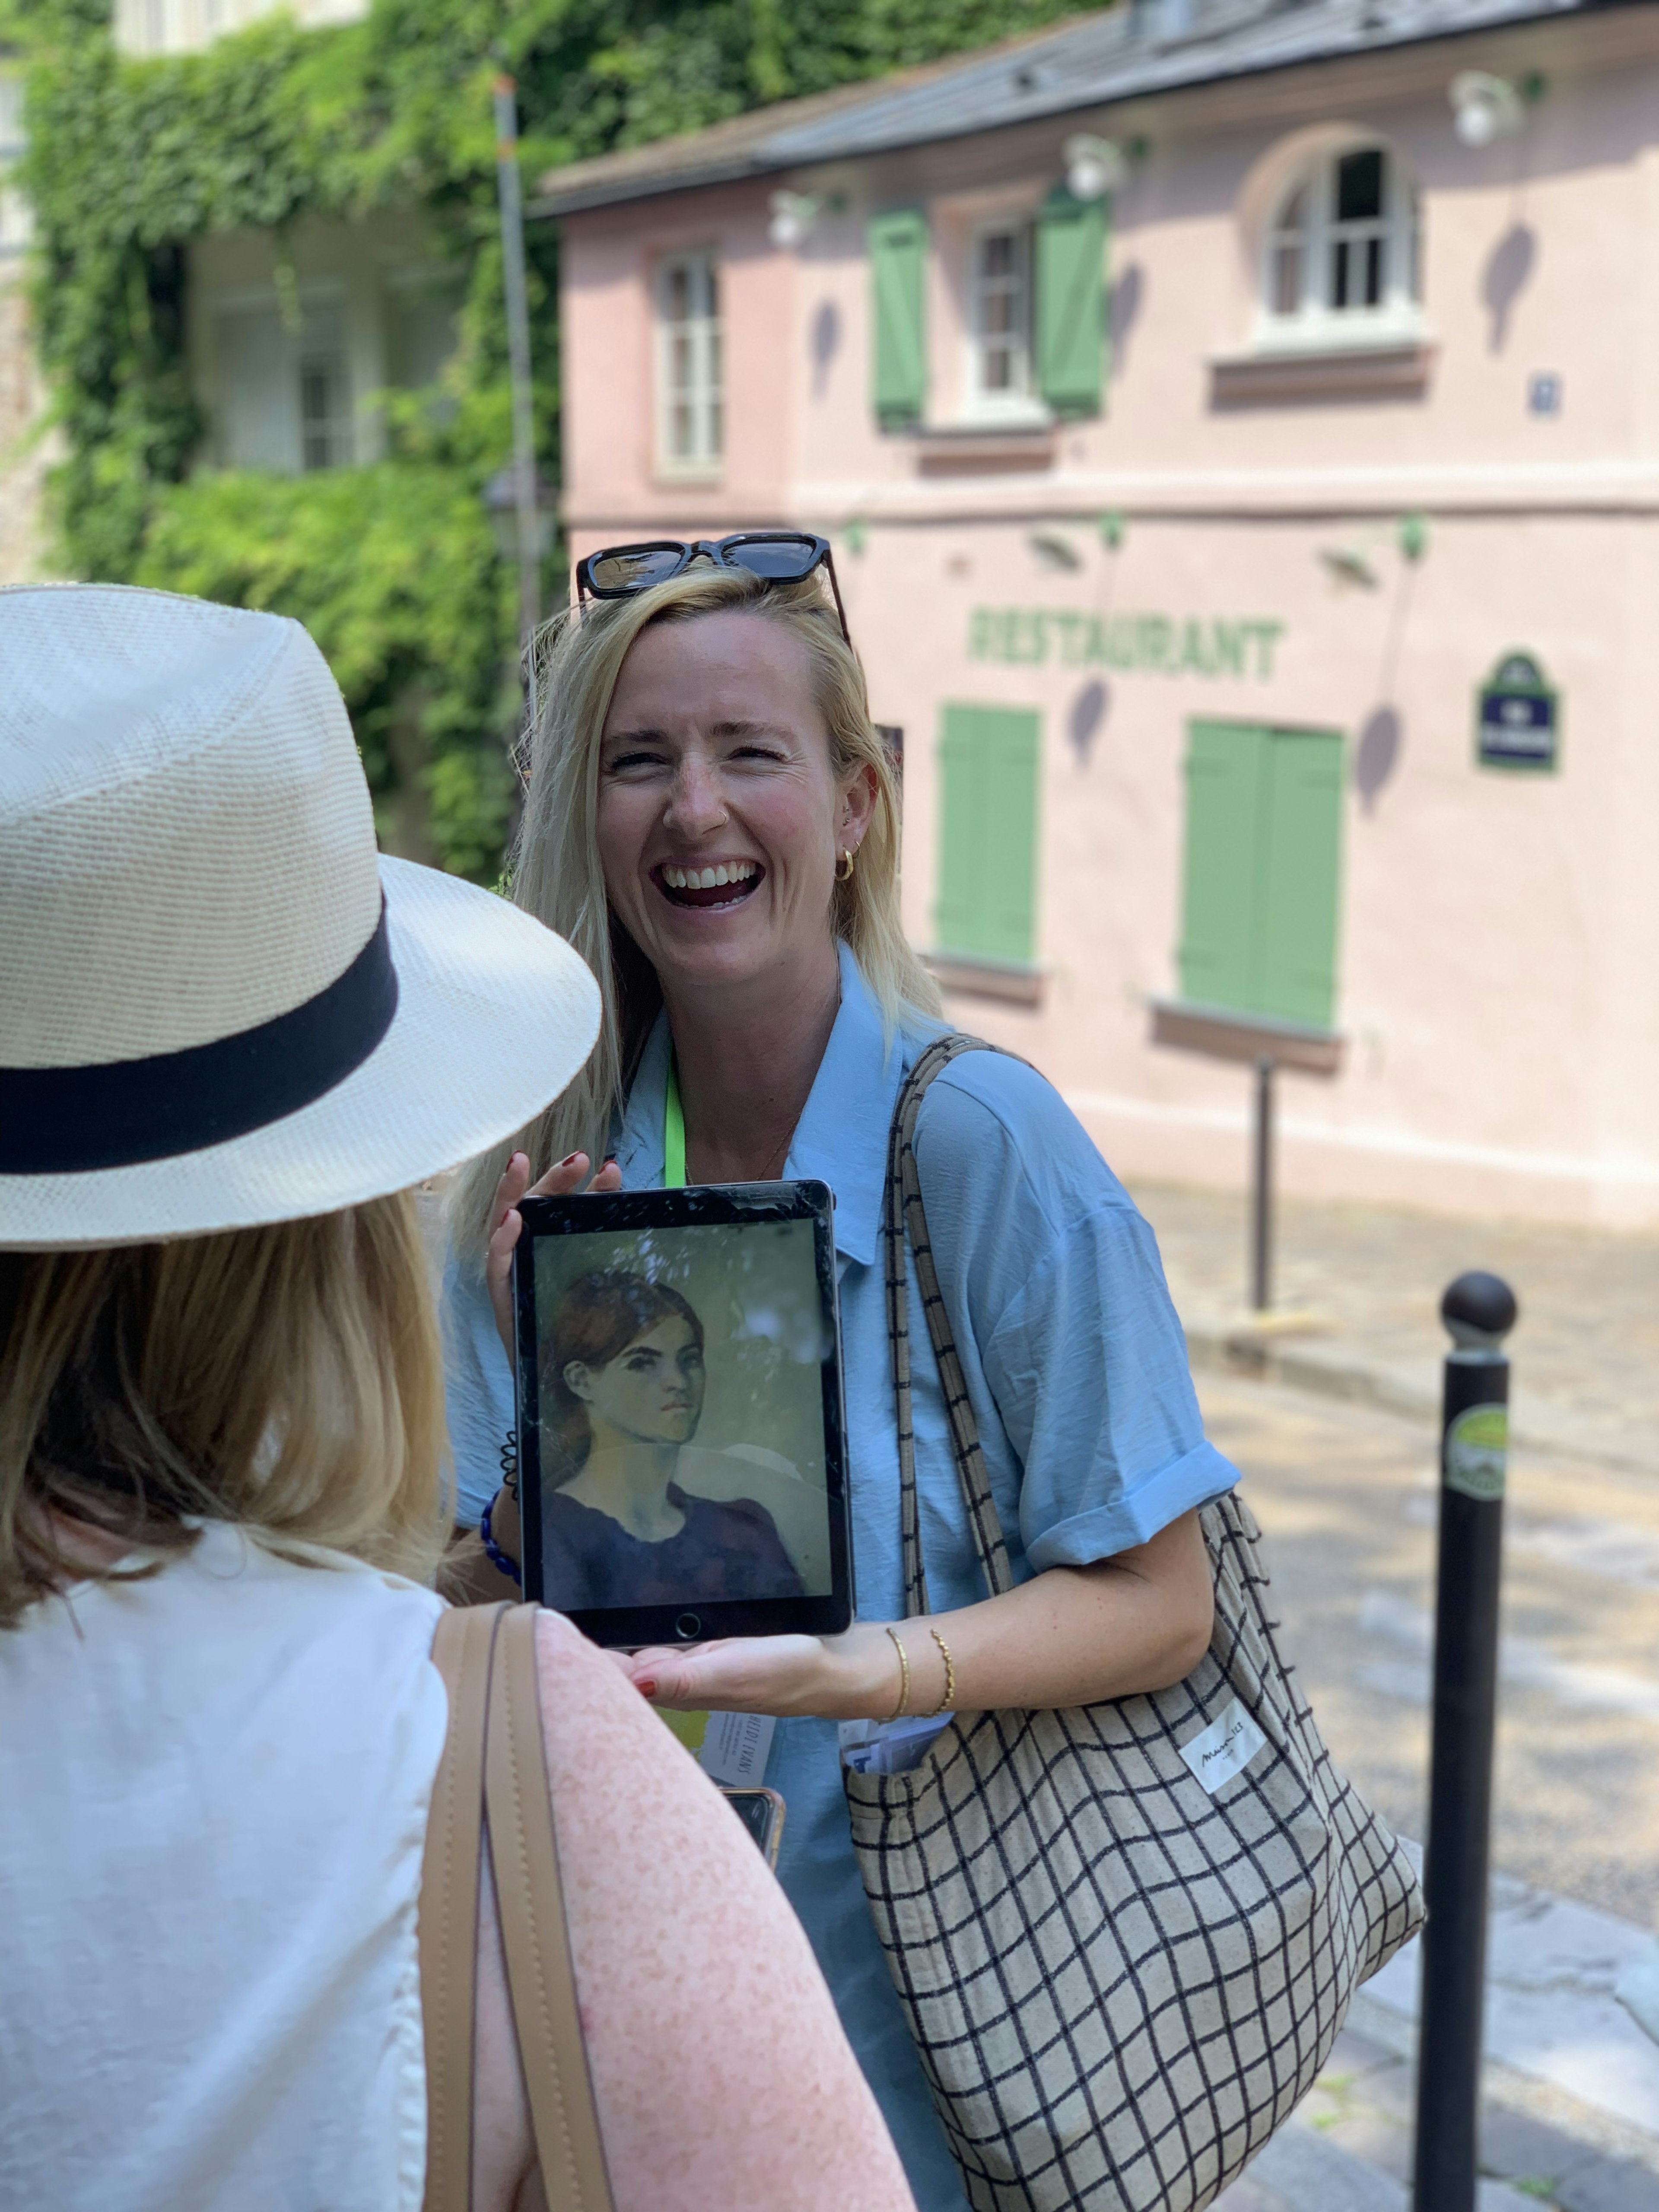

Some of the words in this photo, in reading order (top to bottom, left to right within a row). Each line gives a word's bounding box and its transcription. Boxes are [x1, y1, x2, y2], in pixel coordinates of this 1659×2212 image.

[969, 605, 1287, 682] RESTAURANT
[744, 1715, 762, 1743] HEIDI
[737, 1744, 755, 1774] EVANS
